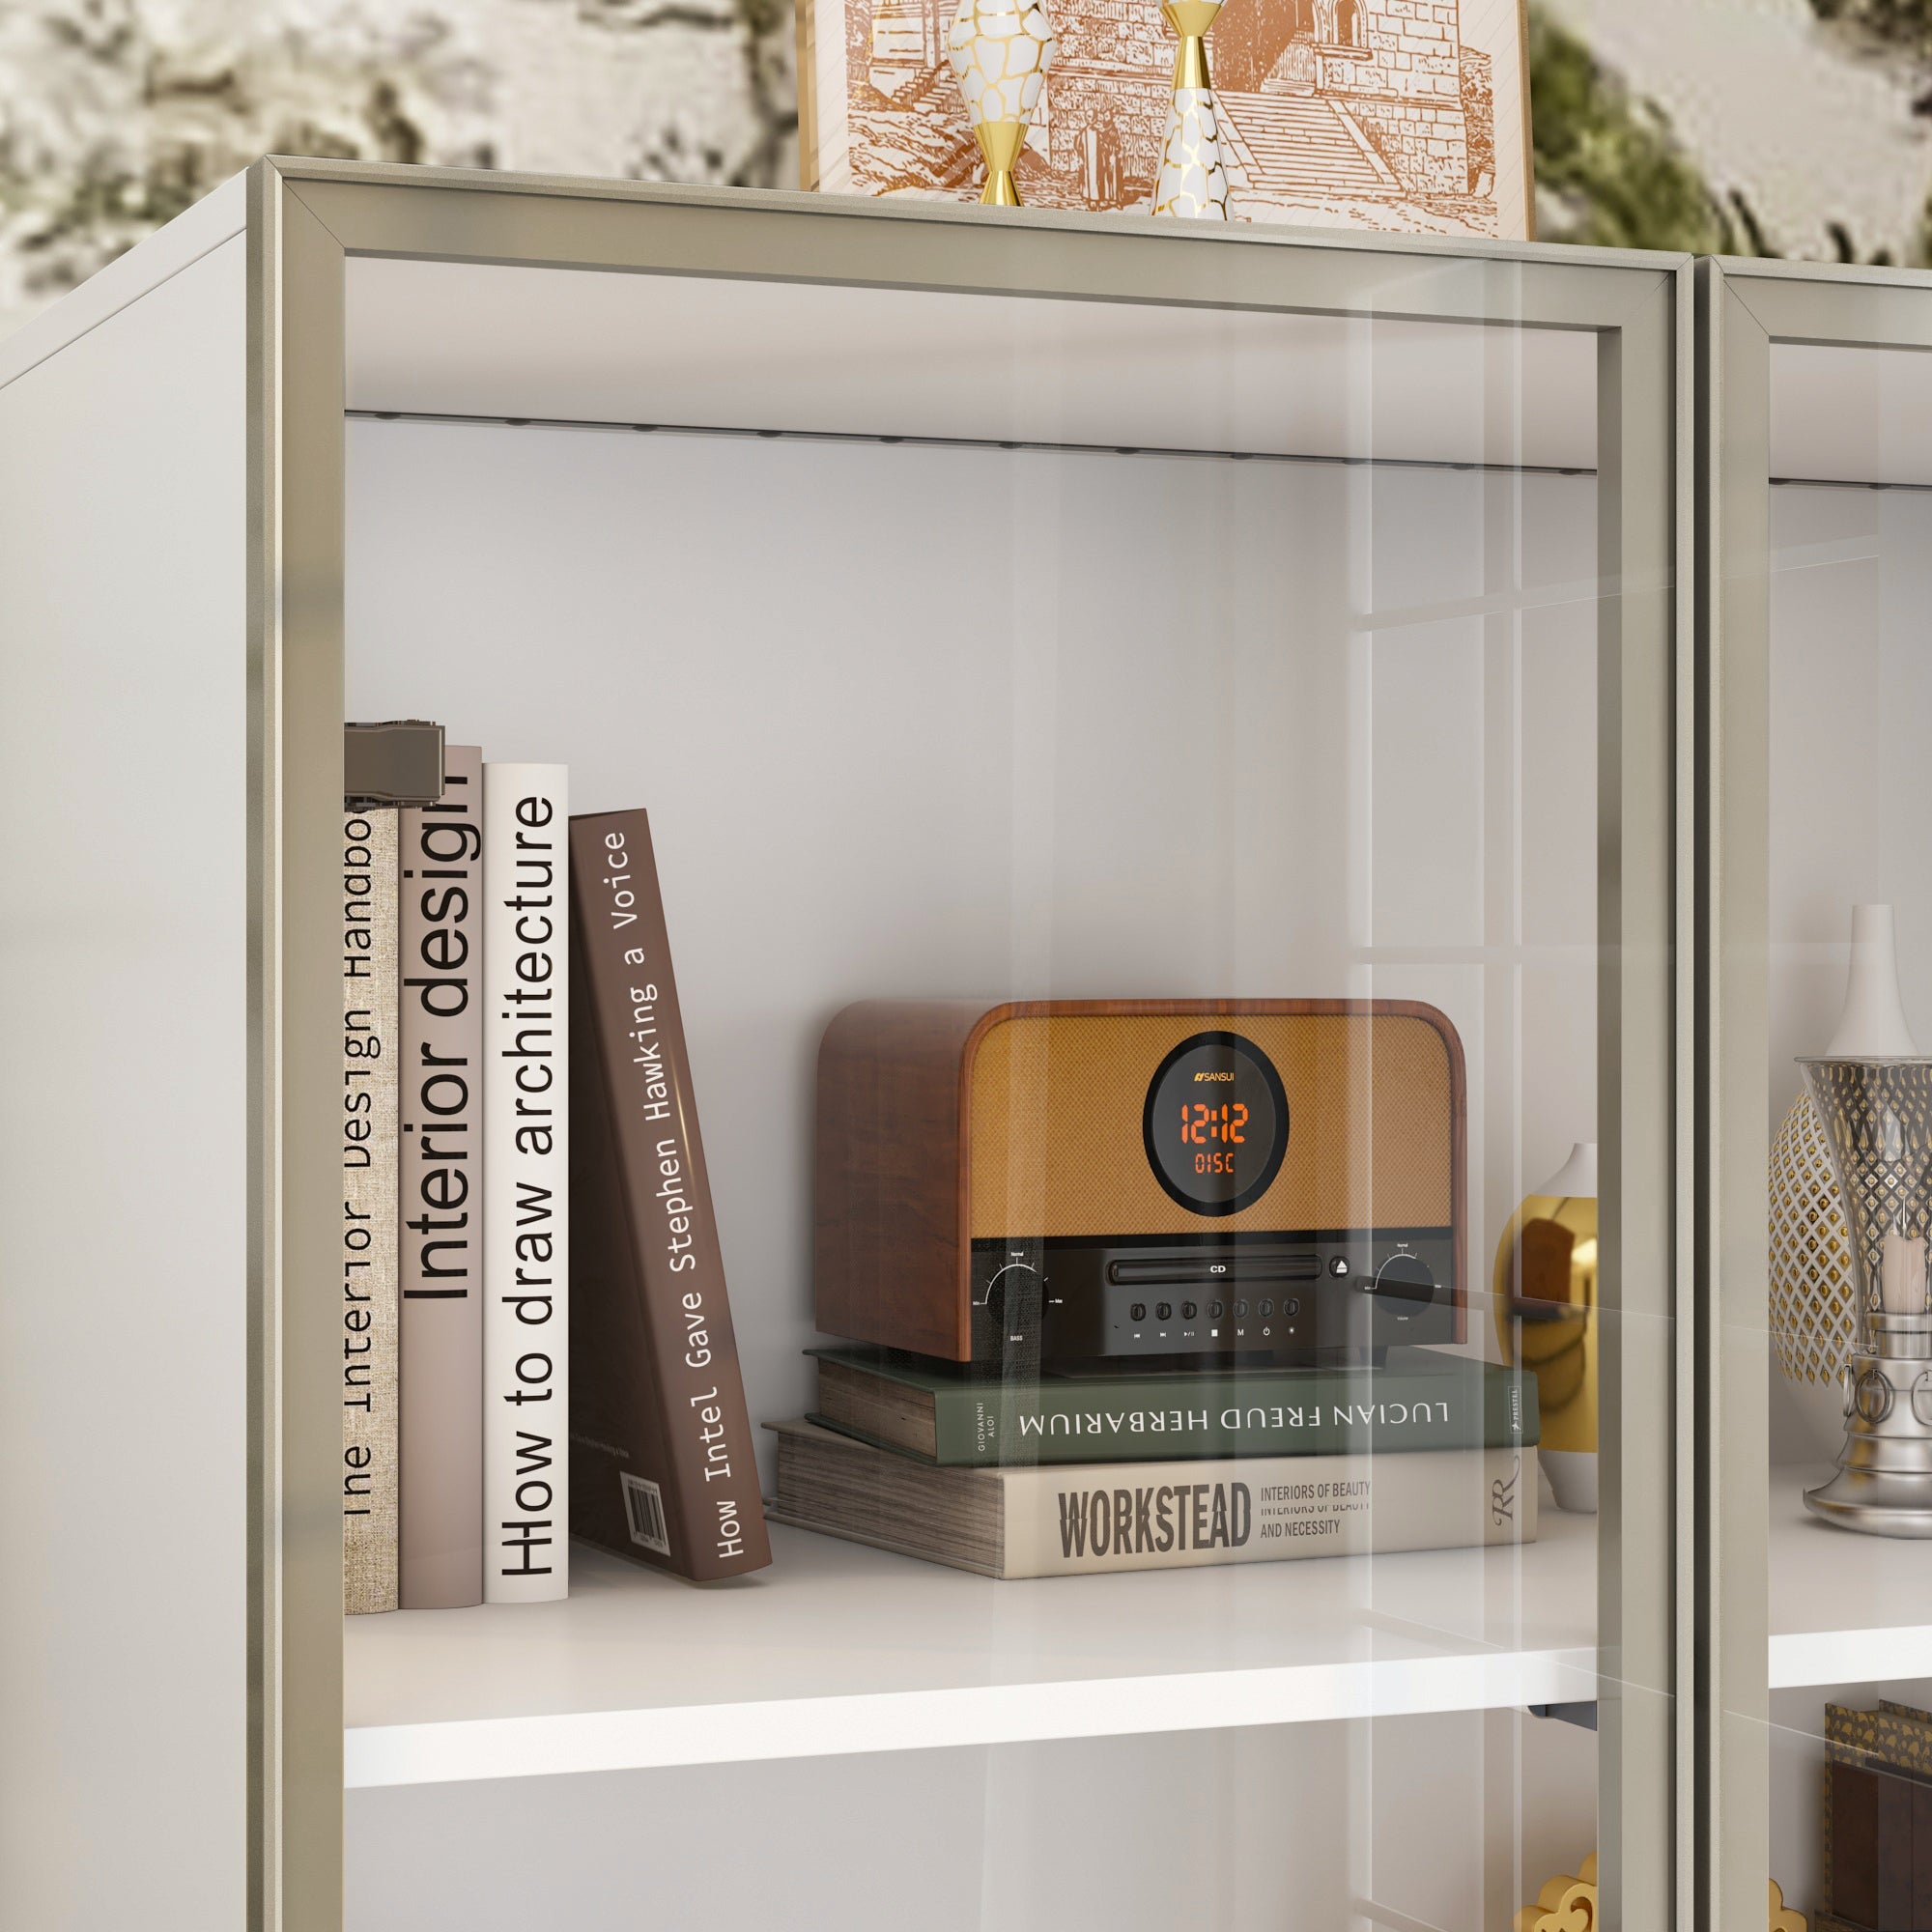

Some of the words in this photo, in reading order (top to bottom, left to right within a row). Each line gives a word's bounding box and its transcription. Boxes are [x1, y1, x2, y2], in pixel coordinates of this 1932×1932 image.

[603, 832, 639, 929] Voice
[502, 797, 552, 1154] architecture
[624, 948, 645, 966] a
[630, 983, 671, 1121] Hawking
[1204, 1072, 1235, 1082] SANSUI
[345, 1011, 381, 1167] Design
[1181, 1103, 1249, 1144] 12:12
[404, 1042, 468, 1298] Interior
[656, 1139, 696, 1272] Stephen
[502, 1182, 552, 1324] draw
[1209, 1264, 1226, 1273] CD
[345, 1202, 371, 1411] Interior
[682, 1292, 712, 1368] Gave
[504, 1353, 552, 1406] to
[691, 1386, 732, 1482] Intel
[976, 1402, 985, 1452] GIOVANNI
[1019, 1409, 1208, 1436] HERBARIUM
[1221, 1406, 1321, 1430] FREUD
[1334, 1403, 1449, 1426] LUCIAN
[502, 1432, 552, 1575] How
[1058, 1482, 1252, 1559] WORKSTEAD
[1261, 1484, 1315, 1502] INTERIORS
[1317, 1483, 1331, 1498] OF
[1332, 1480, 1371, 1497] BEAUTY
[717, 1500, 744, 1558] How
[1260, 1523, 1283, 1539] AND
[1285, 1520, 1341, 1537] NECESSITY
